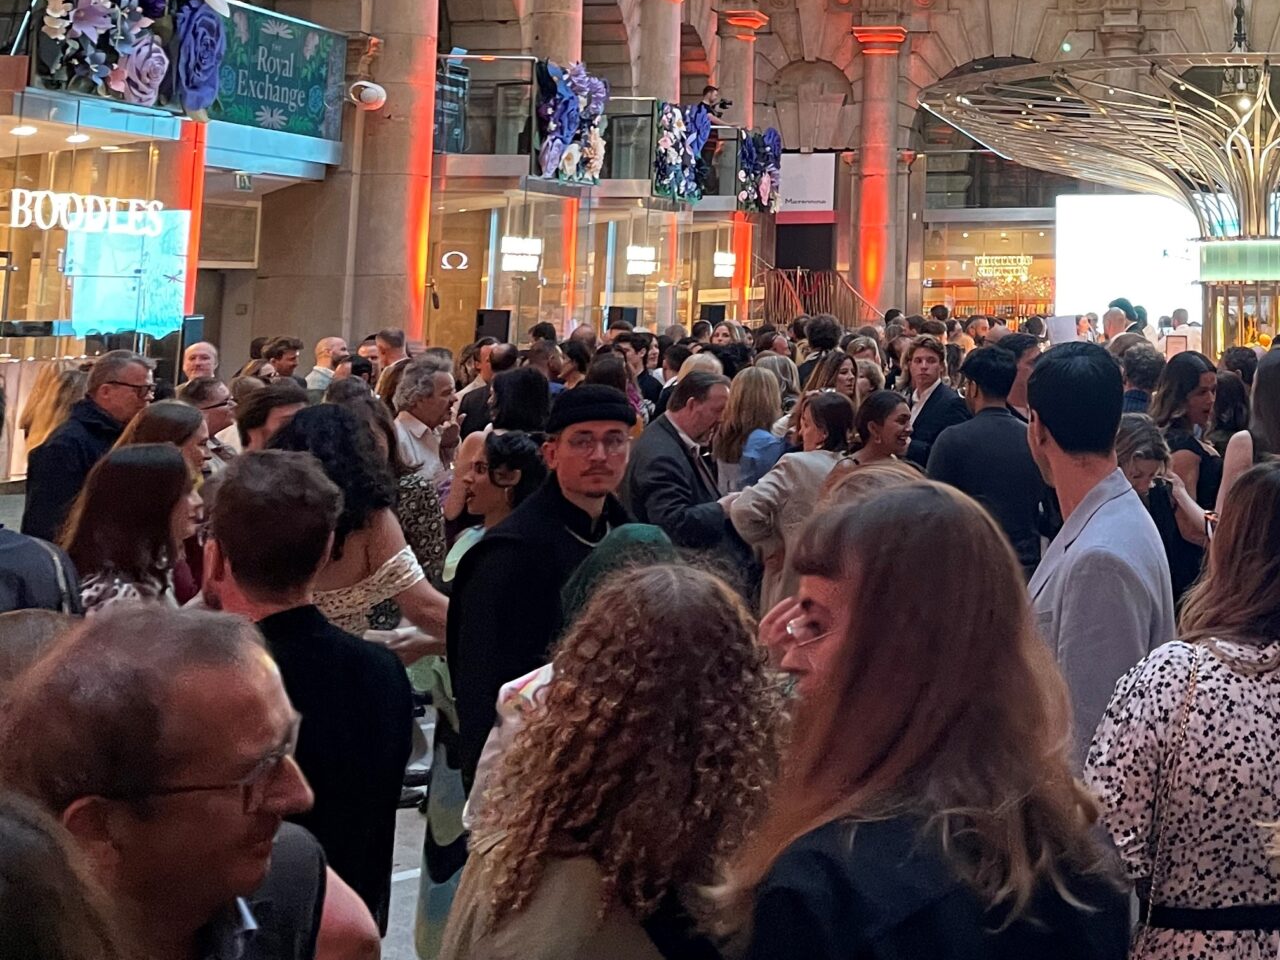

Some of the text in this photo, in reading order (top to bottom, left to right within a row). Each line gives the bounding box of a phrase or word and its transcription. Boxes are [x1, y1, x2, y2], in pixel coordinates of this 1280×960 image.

[257, 45, 294, 81] Royal
[237, 69, 306, 112] Exchange
[10, 188, 164, 237] BOODLES
